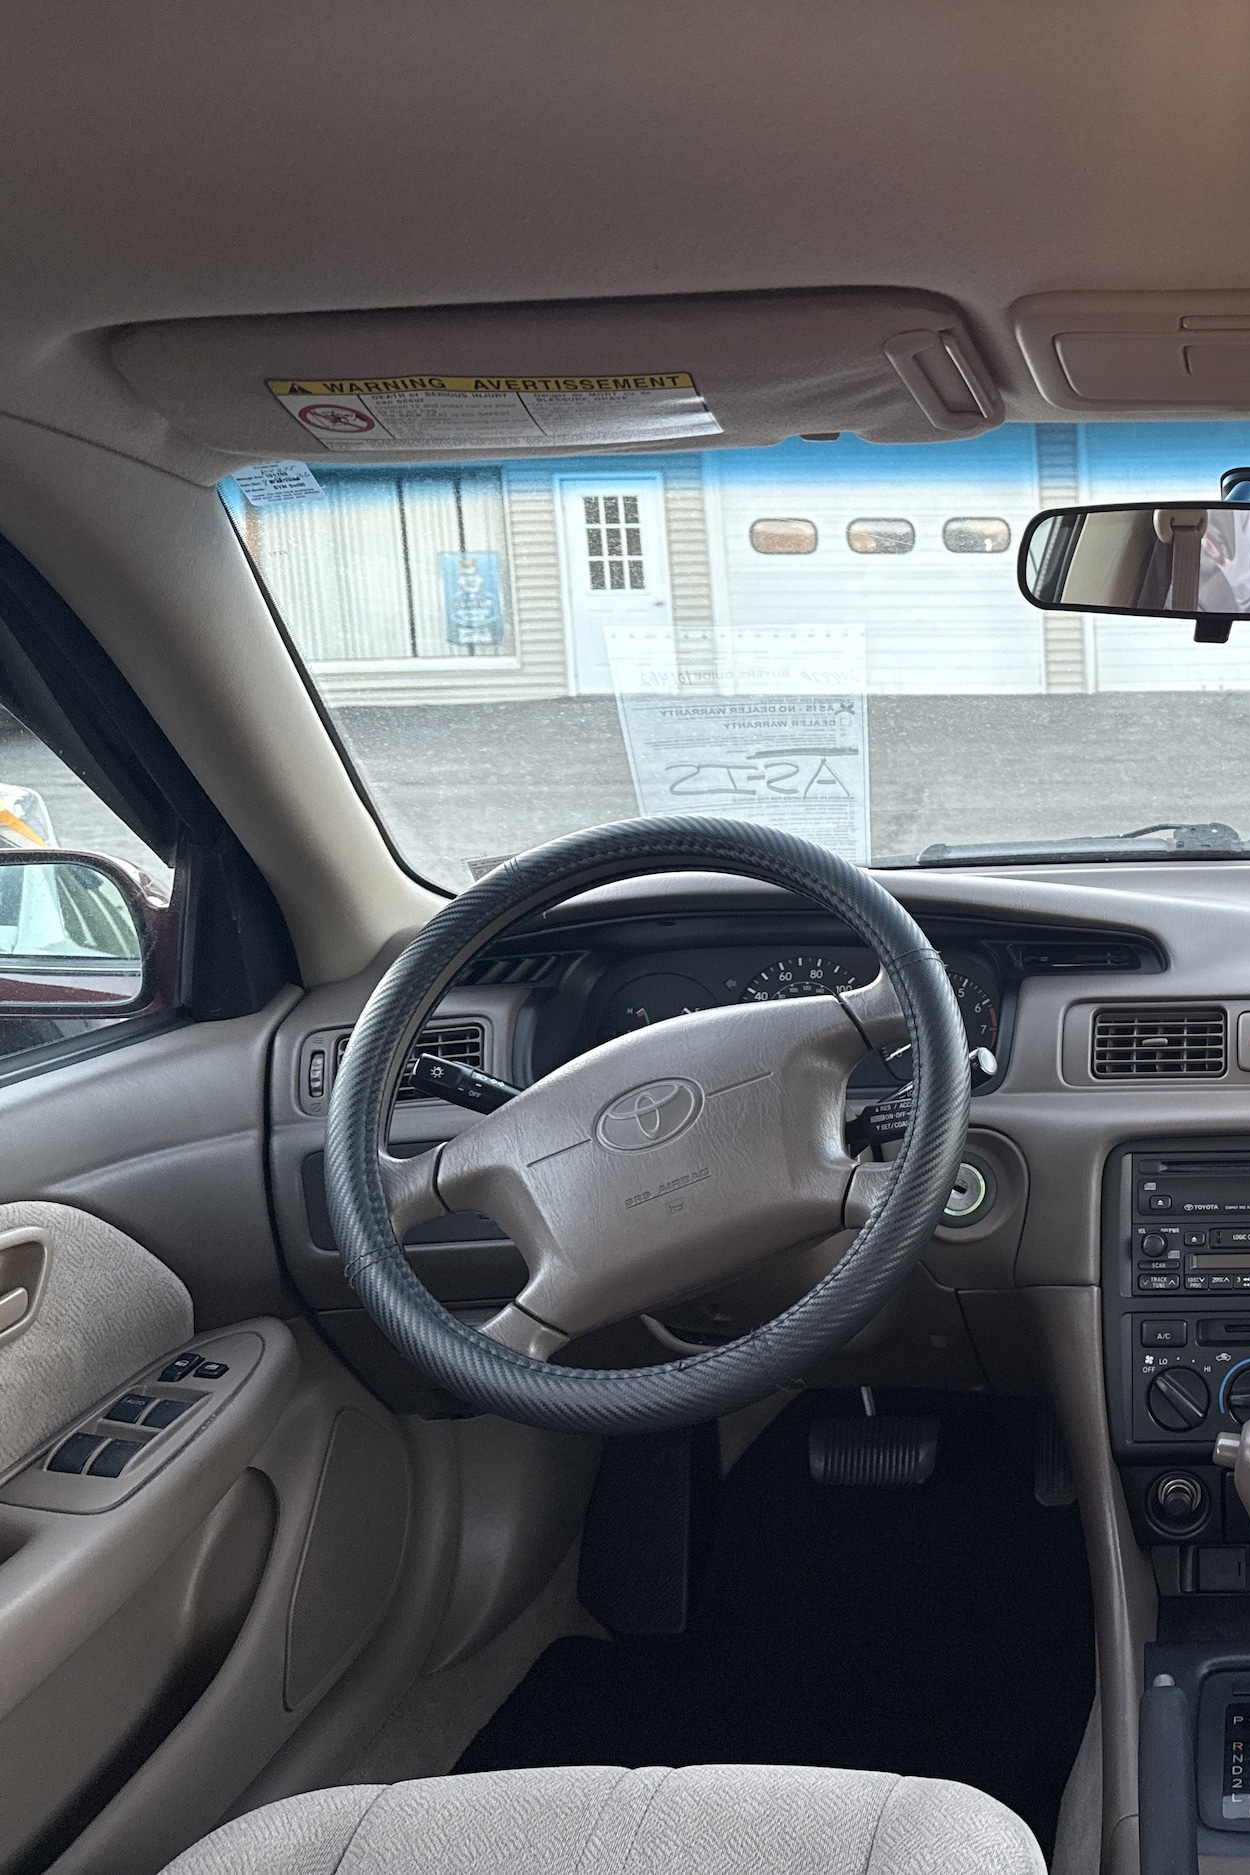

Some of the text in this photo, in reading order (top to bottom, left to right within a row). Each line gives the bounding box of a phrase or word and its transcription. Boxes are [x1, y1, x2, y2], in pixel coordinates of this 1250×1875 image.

[323, 375, 681, 394] WARNING AVERTISSEMENT
[779, 972, 793, 981] 60
[810, 969, 823, 979] 80
[835, 985, 853, 994] 100
[958, 988, 965, 998] 5
[754, 991, 769, 1000] 40
[974, 1003, 982, 1013] 6
[980, 1024, 987, 1035] 7
[468, 1090, 481, 1098] OFF
[881, 1121, 909, 1131] SET/COA
[1233, 1716, 1244, 1725] P
[1232, 1742, 1243, 1751] R
[1232, 1754, 1243, 1763] N
[1232, 1766, 1243, 1775] D
[1232, 1778, 1243, 1788] 2
[1232, 1793, 1242, 1802] L
